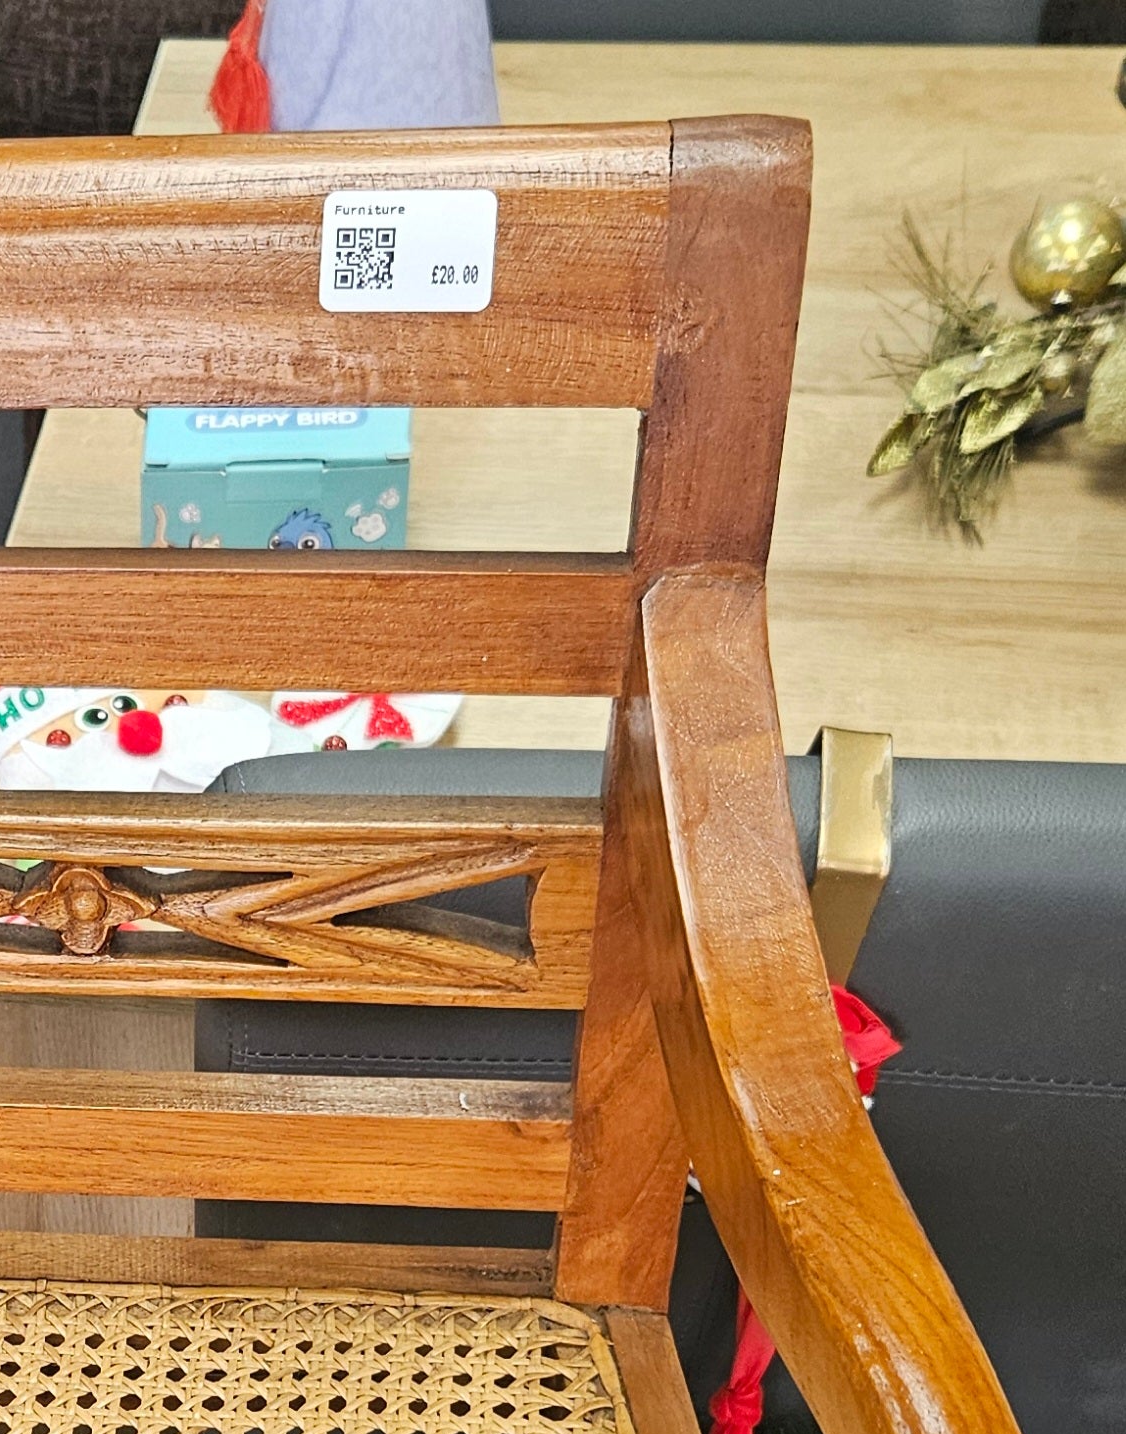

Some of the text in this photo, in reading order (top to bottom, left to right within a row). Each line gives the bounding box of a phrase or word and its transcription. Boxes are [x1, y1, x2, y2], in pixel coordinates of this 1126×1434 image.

[334, 205, 406, 216] Furniture
[431, 264, 479, 285] £20.00
[195, 410, 358, 430] FLAPPY BIRD
